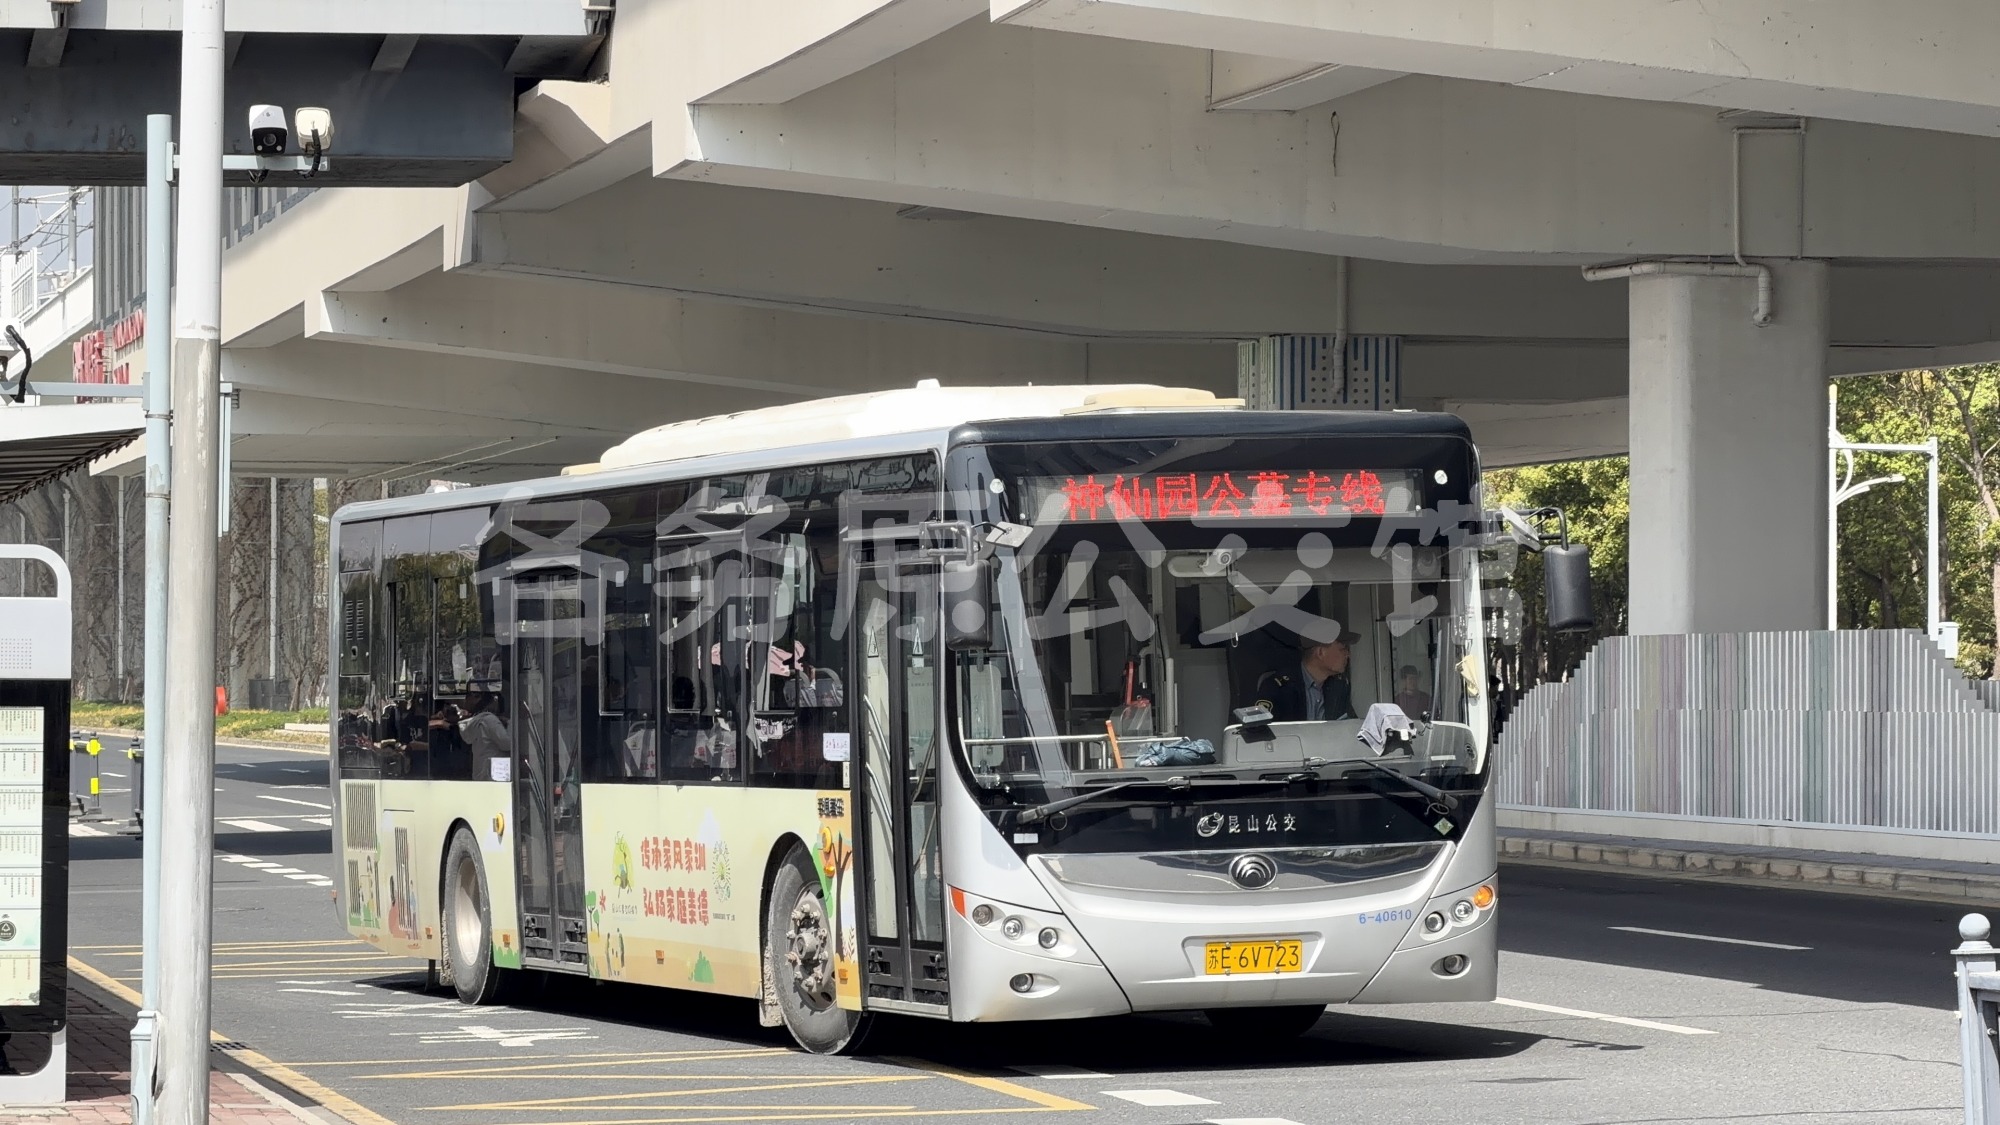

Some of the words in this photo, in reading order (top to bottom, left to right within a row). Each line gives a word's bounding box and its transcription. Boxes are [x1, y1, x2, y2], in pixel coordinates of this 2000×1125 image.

[1061, 469, 1386, 521] 神仙园公墓专线
[1228, 813, 1297, 833] 昆山公交
[640, 836, 707, 874] 传承家风家训
[642, 886, 710, 927] 弘扬家庭美德
[1359, 910, 1412, 925] 6-40610
